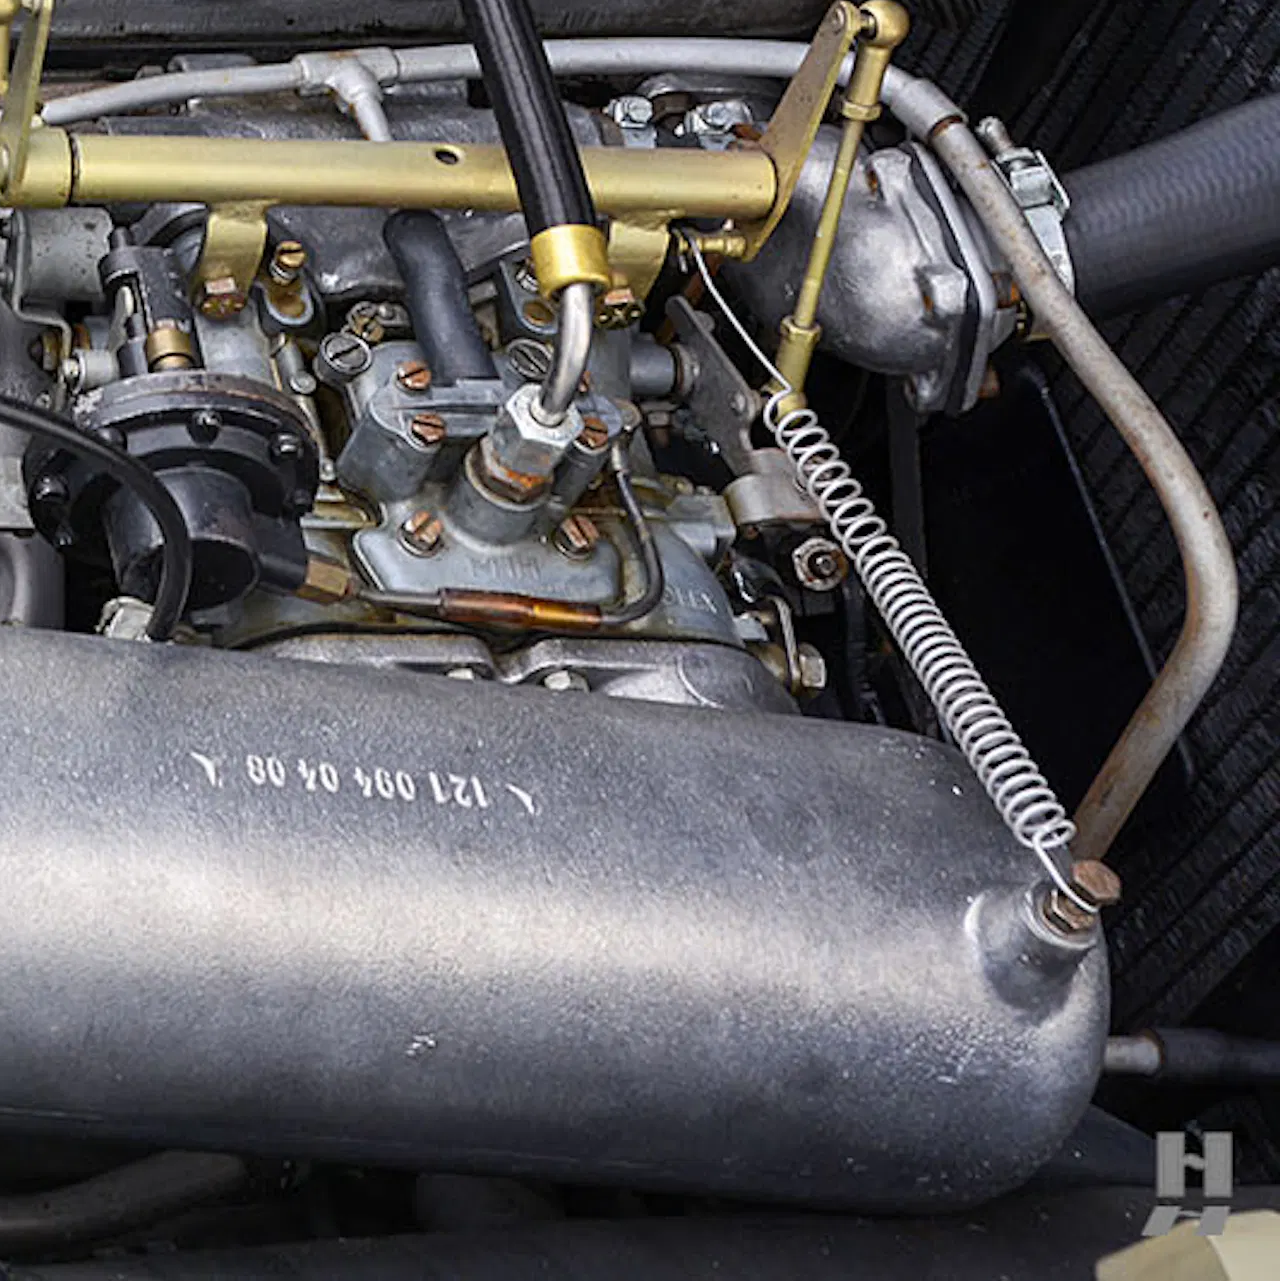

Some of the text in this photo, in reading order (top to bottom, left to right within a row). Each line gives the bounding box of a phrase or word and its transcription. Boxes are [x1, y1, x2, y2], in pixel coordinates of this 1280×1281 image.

[245, 752, 286, 788] 08
[296, 757, 340, 793] 04
[428, 771, 490, 808] 121
